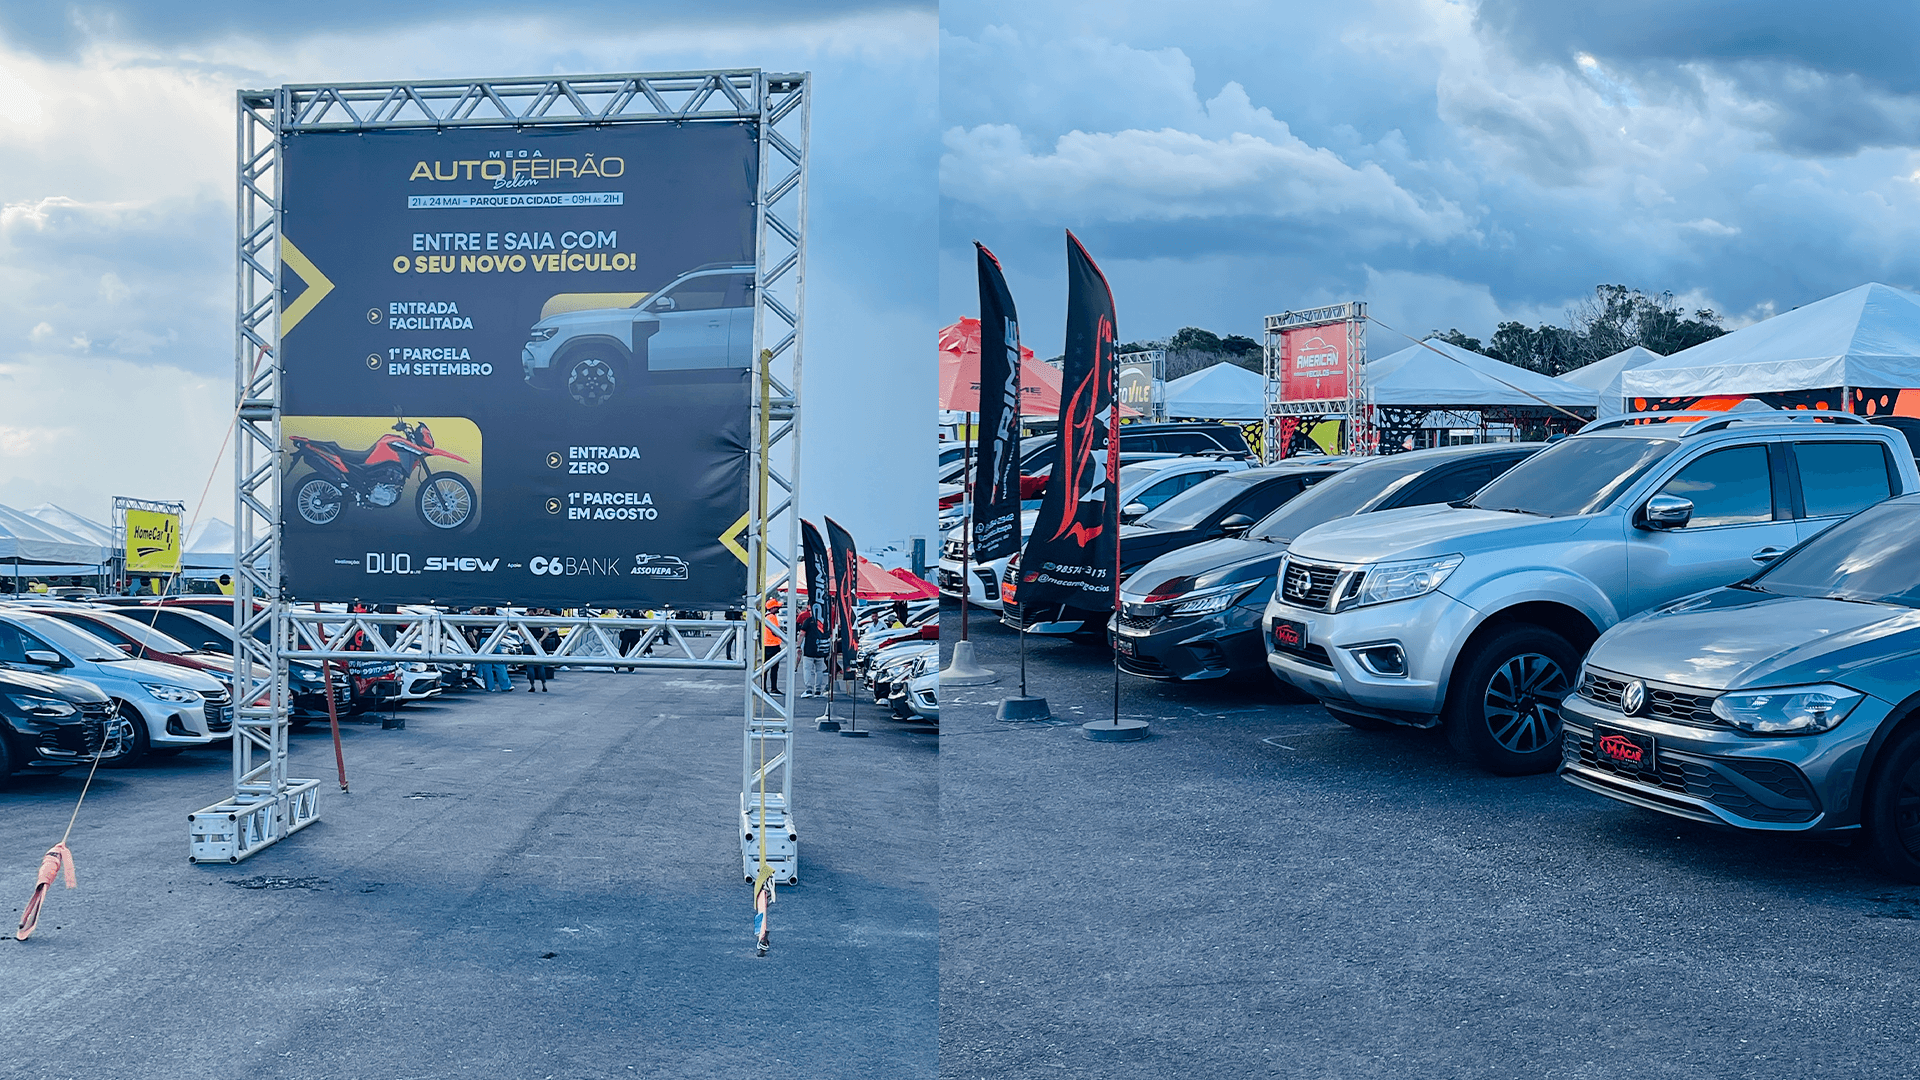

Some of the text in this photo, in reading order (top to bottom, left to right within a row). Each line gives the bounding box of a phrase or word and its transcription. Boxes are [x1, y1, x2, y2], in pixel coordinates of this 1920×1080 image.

[489, 150, 542, 158] MEGA
[493, 172, 539, 190] Belém
[412, 197, 421, 206] 21
[429, 197, 442, 206] 24
[442, 197, 461, 206] MAI
[470, 197, 509, 207] PARQUE
[510, 196, 525, 206] DA
[526, 196, 563, 205] CIDADE
[572, 195, 592, 204] 09H
[603, 194, 620, 203] 21H
[412, 231, 617, 251] ENTRE E SAIA COM
[393, 250, 637, 273] O SEU NOVO VEÍCULO!
[389, 302, 458, 315] ENTRADA
[389, 317, 474, 330] FACILITADA
[403, 348, 471, 360] PARCELA
[1296, 353, 1338, 368] AMERICAN
[388, 363, 493, 376] EM SETEMBRO
[990, 316, 1019, 487] PRIME
[569, 446, 641, 459] ENTRADA
[568, 462, 610, 474] ZERO
[583, 492, 653, 505] PARCELA
[568, 507, 658, 520] EM AGOSTO
[133, 525, 163, 541] HomeCar
[630, 566, 672, 576] ASSOVEPA
